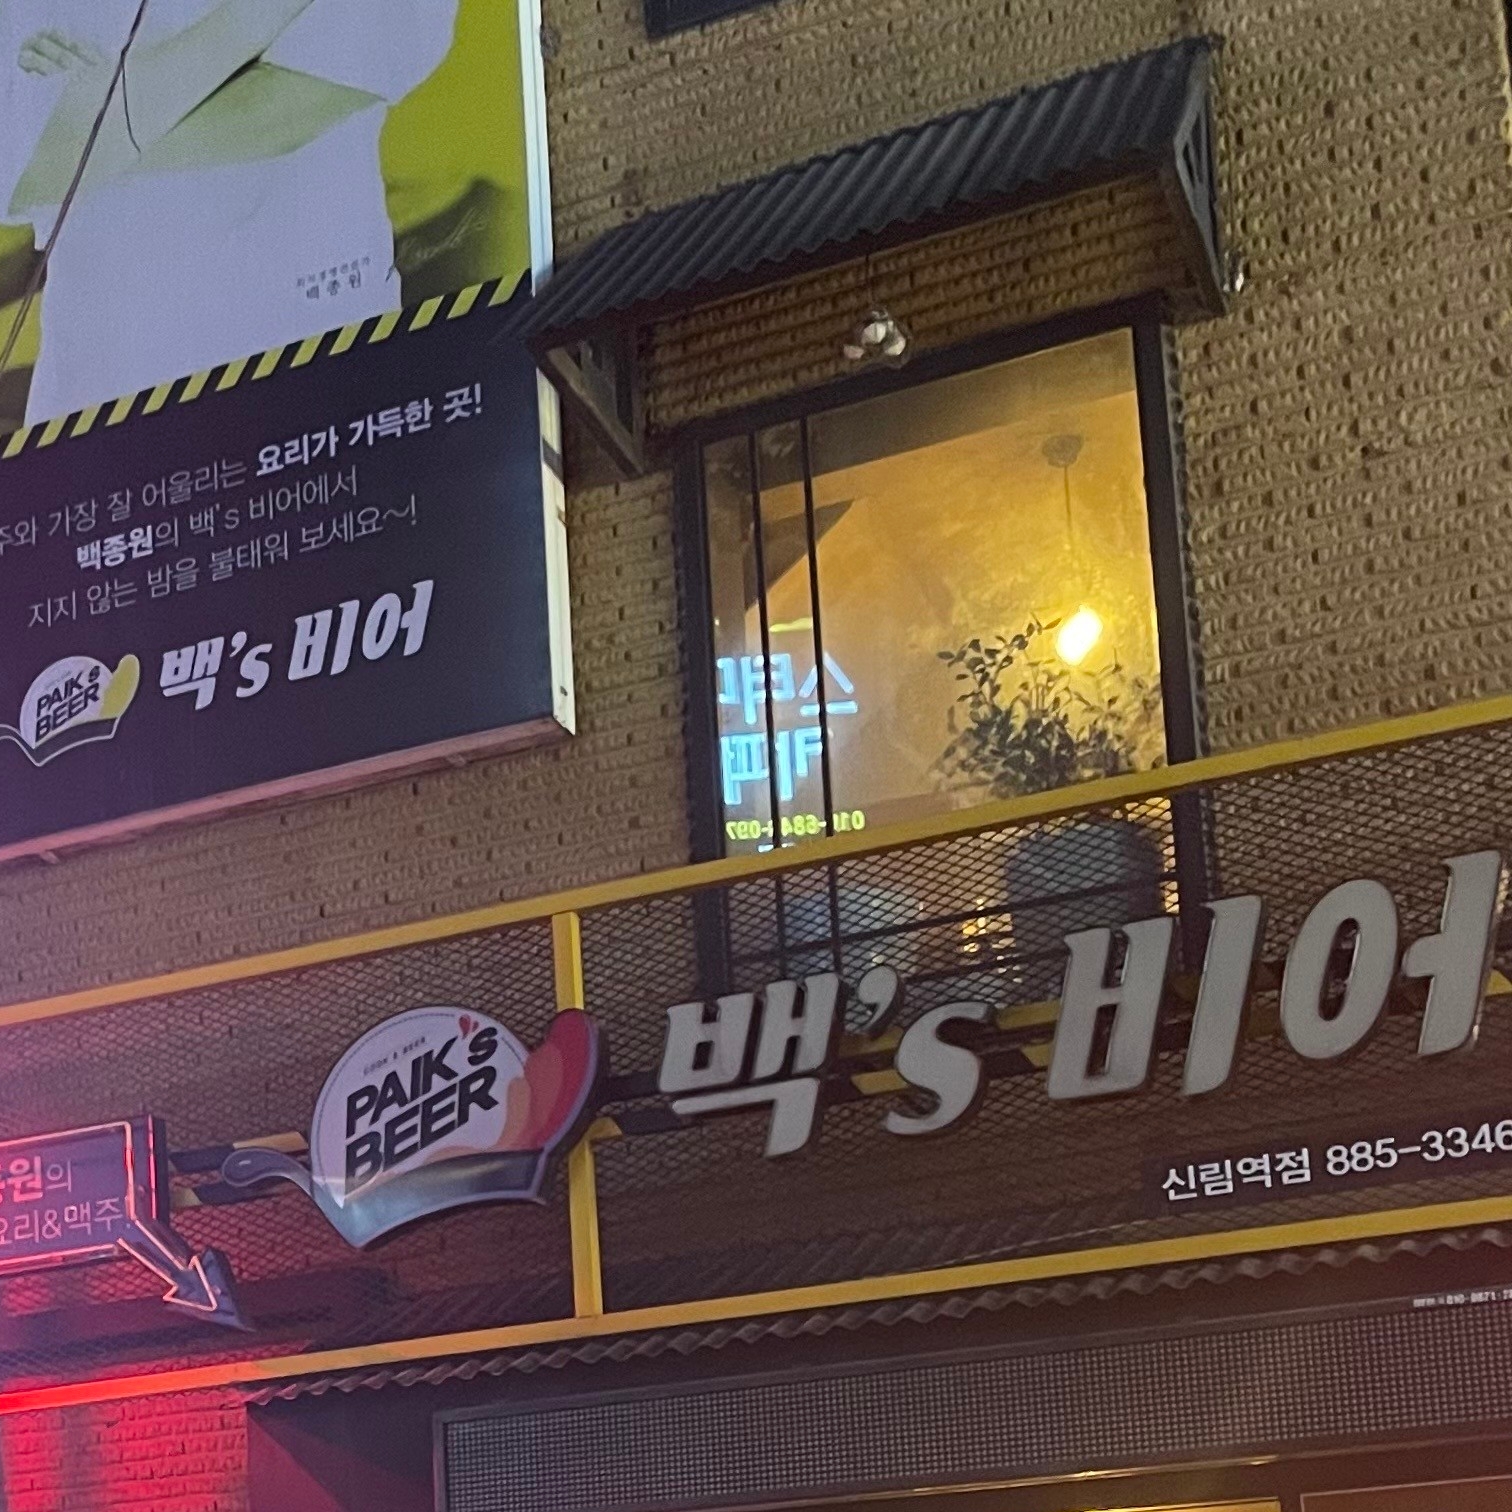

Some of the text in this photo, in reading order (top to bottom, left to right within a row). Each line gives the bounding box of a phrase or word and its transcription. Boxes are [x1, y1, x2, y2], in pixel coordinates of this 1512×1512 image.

[48, 498, 99, 536] 가장
[107, 488, 133, 523] 잘
[142, 459, 248, 508] 어울리는
[256, 425, 340, 477] 요리가
[348, 397, 434, 446] 가득한
[443, 382, 482, 424] 곳!
[76, 517, 179, 570] 백종원의
[249, 464, 358, 520] 비어에서
[27, 590, 78, 628] 지지
[86, 577, 138, 616] 않는
[147, 556, 200, 598] 밤을
[208, 529, 289, 582] 불태워
[159, 579, 435, 711] 백's 비어
[36, 682, 101, 744] BEER
[656, 848, 1505, 1158] 백's 비어
[344, 1065, 500, 1197] BEER
[1161, 1118, 1512, 1201] 신림역점 885-3346
